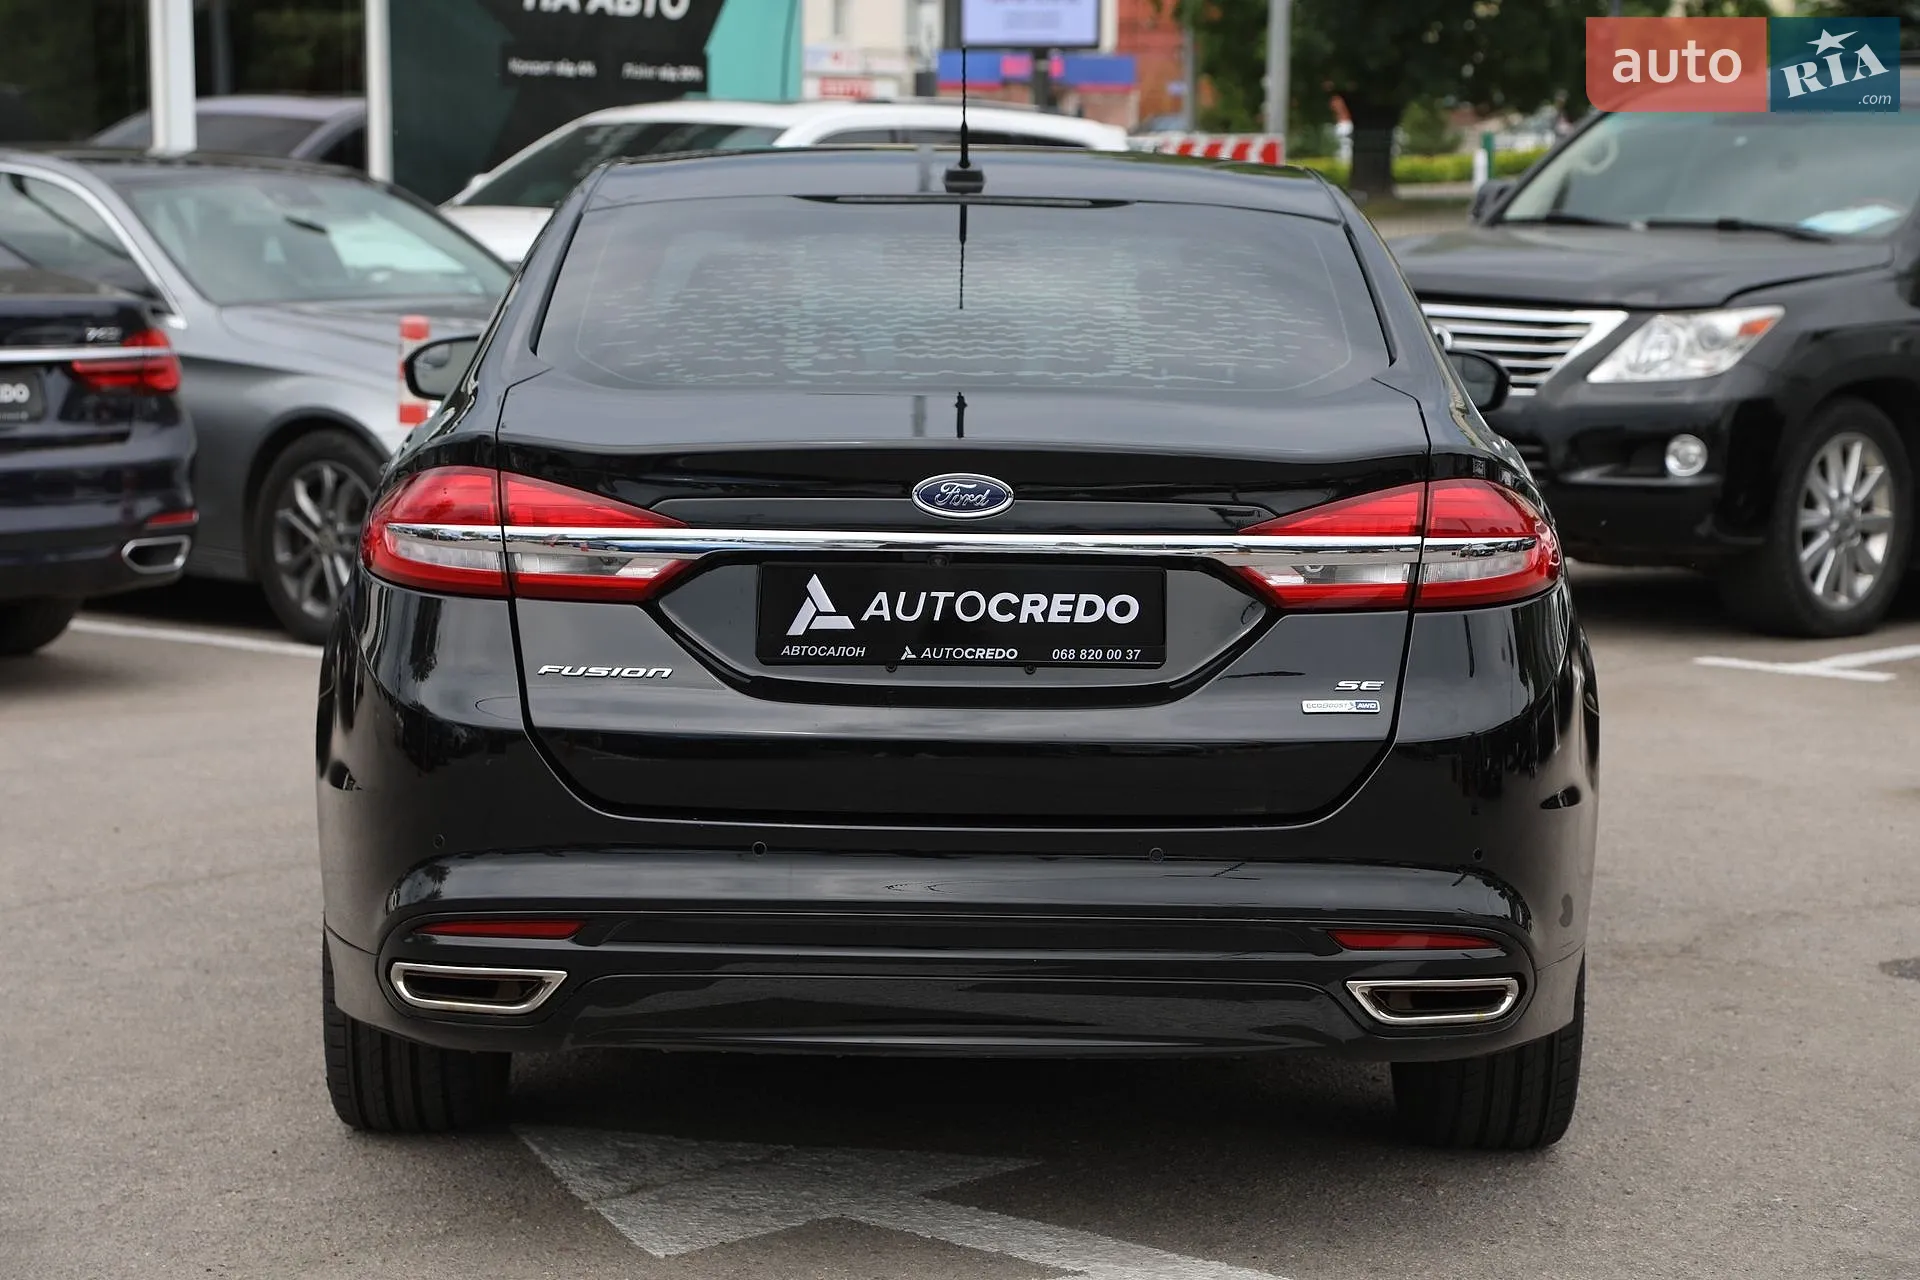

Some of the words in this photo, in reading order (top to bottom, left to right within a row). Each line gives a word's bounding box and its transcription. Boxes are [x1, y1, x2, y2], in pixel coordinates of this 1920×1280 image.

[934, 482, 990, 506] Ford
[860, 591, 1140, 625] AUTOCREDO
[781, 645, 866, 657] АВТОСАЛОН
[920, 647, 1018, 660] AUTOCREDO
[1052, 649, 1076, 660] 068
[1079, 649, 1102, 660] 820
[1106, 649, 1122, 660] 00
[1125, 649, 1141, 660] 37
[537, 665, 674, 679] FUSION
[1335, 680, 1385, 691] SE
